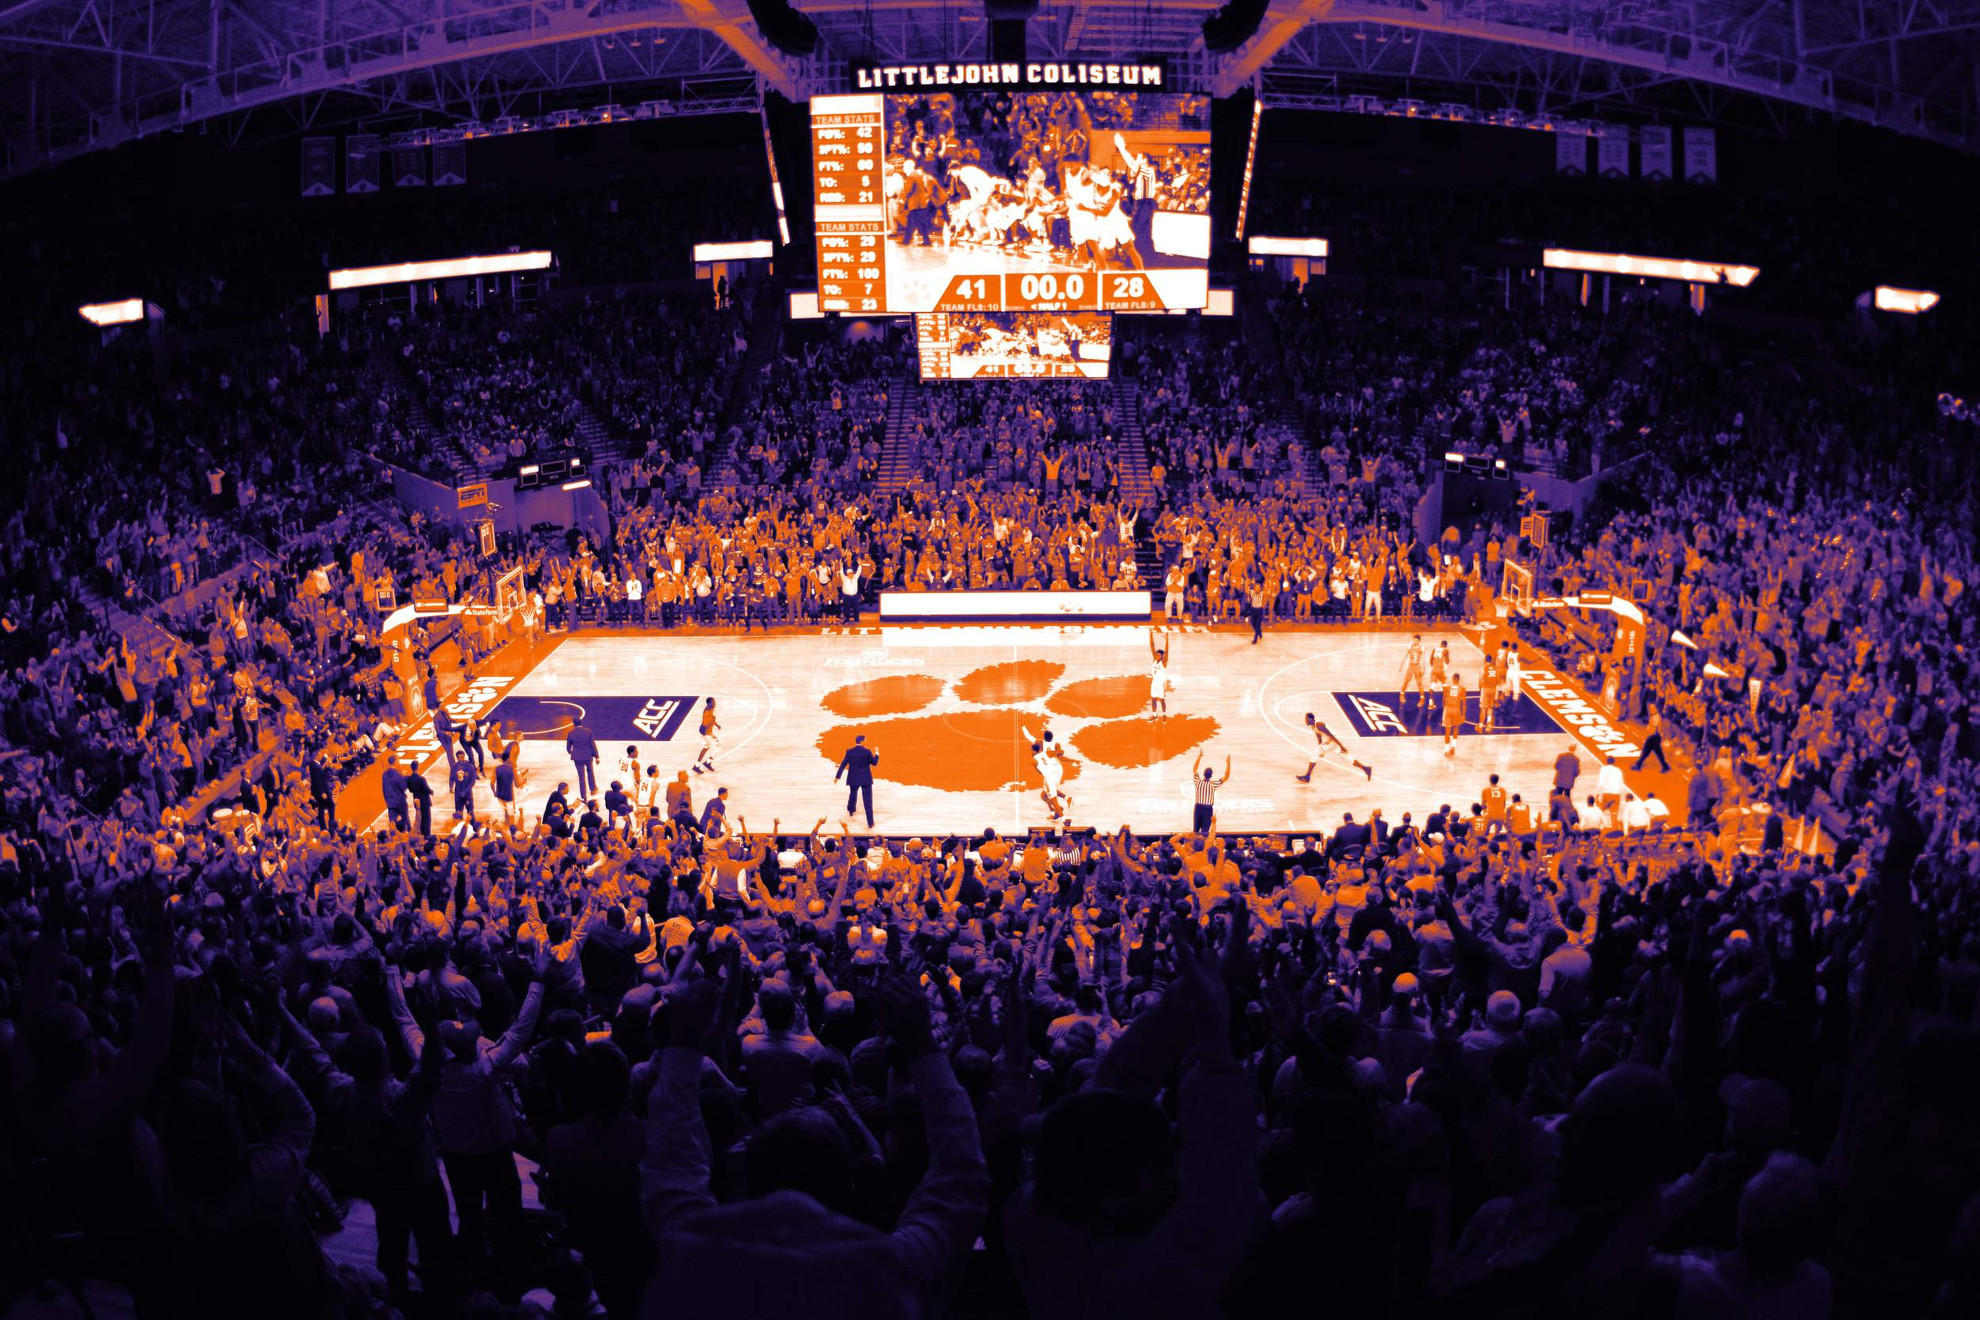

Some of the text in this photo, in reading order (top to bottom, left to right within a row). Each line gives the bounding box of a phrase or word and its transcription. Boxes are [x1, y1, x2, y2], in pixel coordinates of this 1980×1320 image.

[858, 64, 1162, 88] LITTLEJOHN COLISEUM
[816, 115, 875, 125] TEAM STATS
[857, 126, 872, 138] 42
[819, 177, 837, 187] TO:
[859, 191, 873, 203] 21
[821, 223, 879, 231] TEAM STATS
[823, 283, 873, 295] TO: 7
[956, 279, 986, 299] 41
[1020, 274, 1084, 300] 00.0
[1113, 276, 1144, 298] 28
[940, 304, 965, 312] TEAM
[988, 303, 999, 311] 10
[1105, 302, 1129, 310] TEAM
[1487, 669, 1496, 677] 32
[633, 698, 674, 736] ACC
[1356, 697, 1408, 734] ACC
[620, 762, 629, 773] 20
[641, 782, 648, 792] 24
[1491, 790, 1501, 798] 13
[1475, 822, 1484, 831] 21
